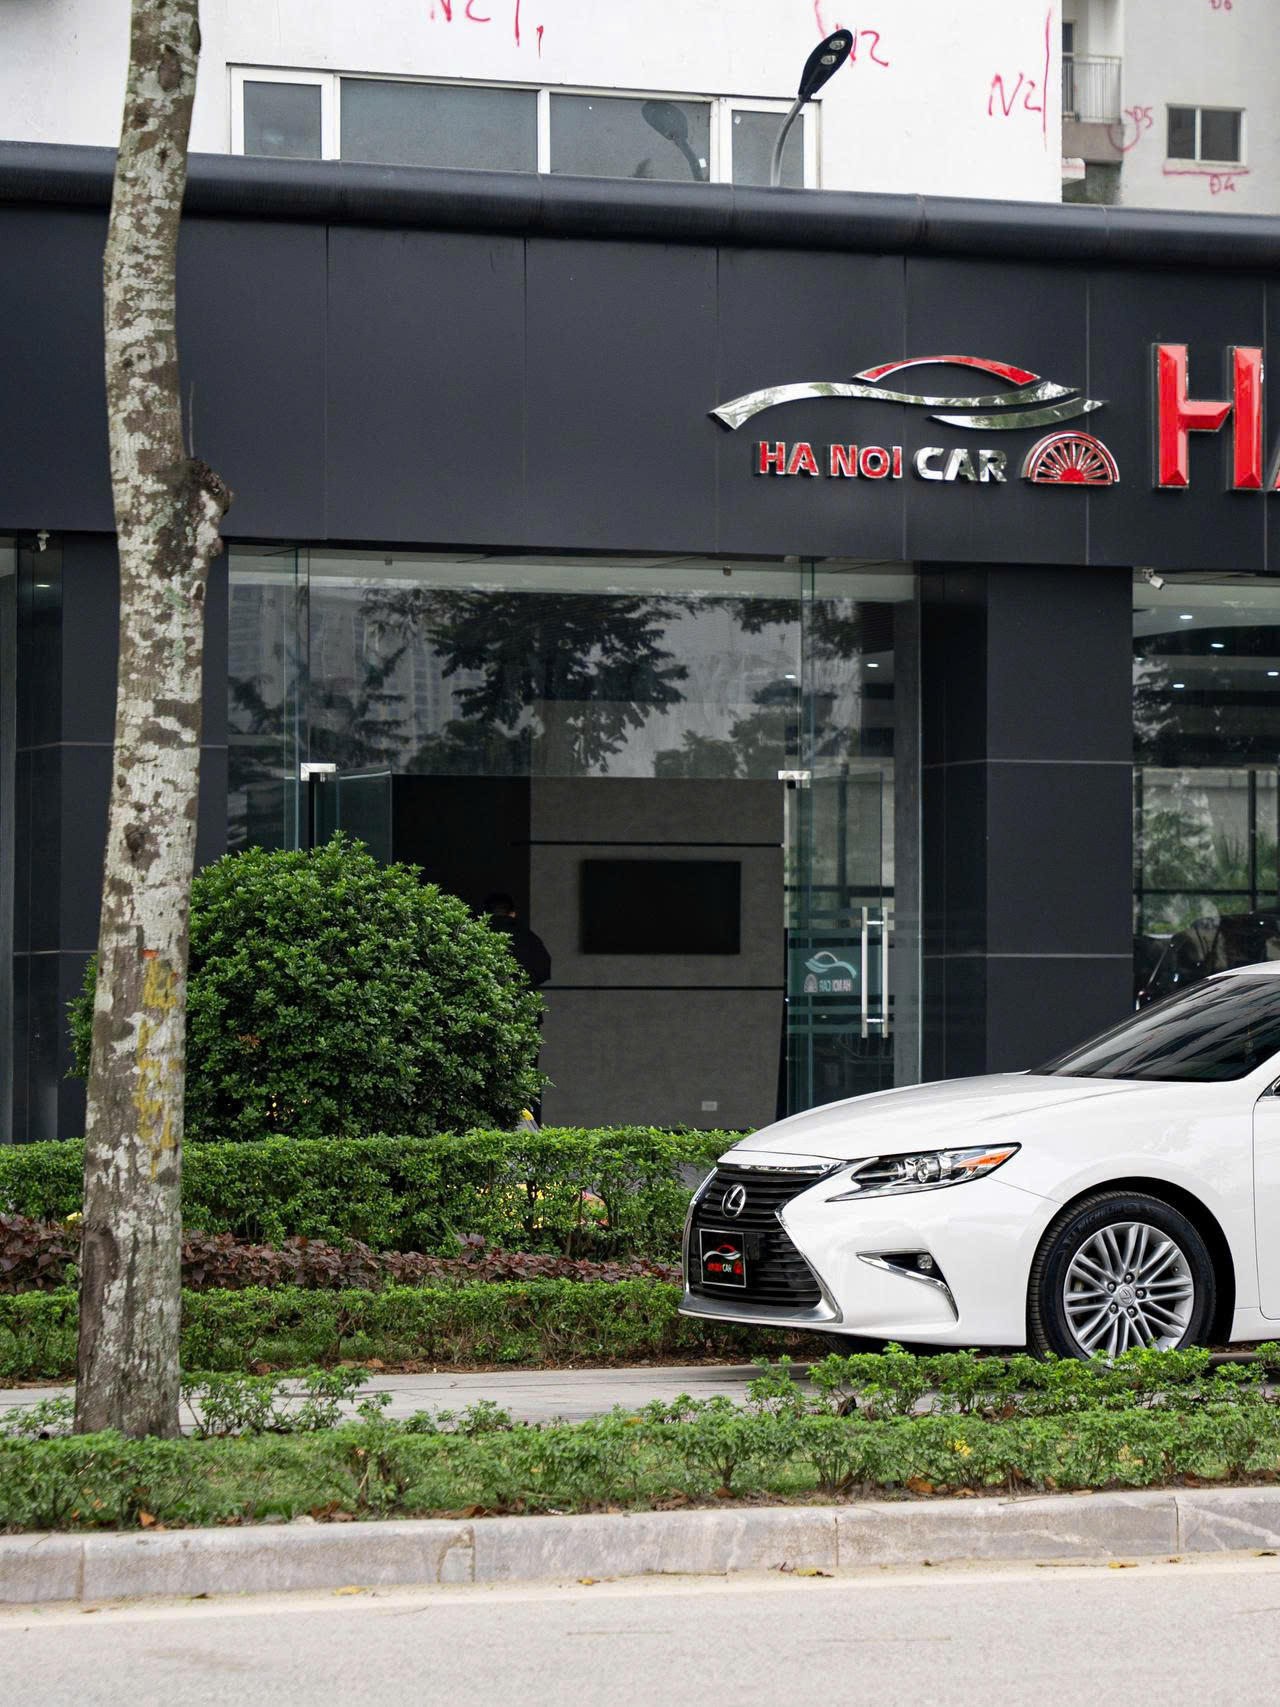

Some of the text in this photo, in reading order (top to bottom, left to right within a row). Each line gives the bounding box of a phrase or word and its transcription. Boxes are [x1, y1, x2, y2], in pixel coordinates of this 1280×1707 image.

[757, 440, 1008, 482] HA NOI CAR
